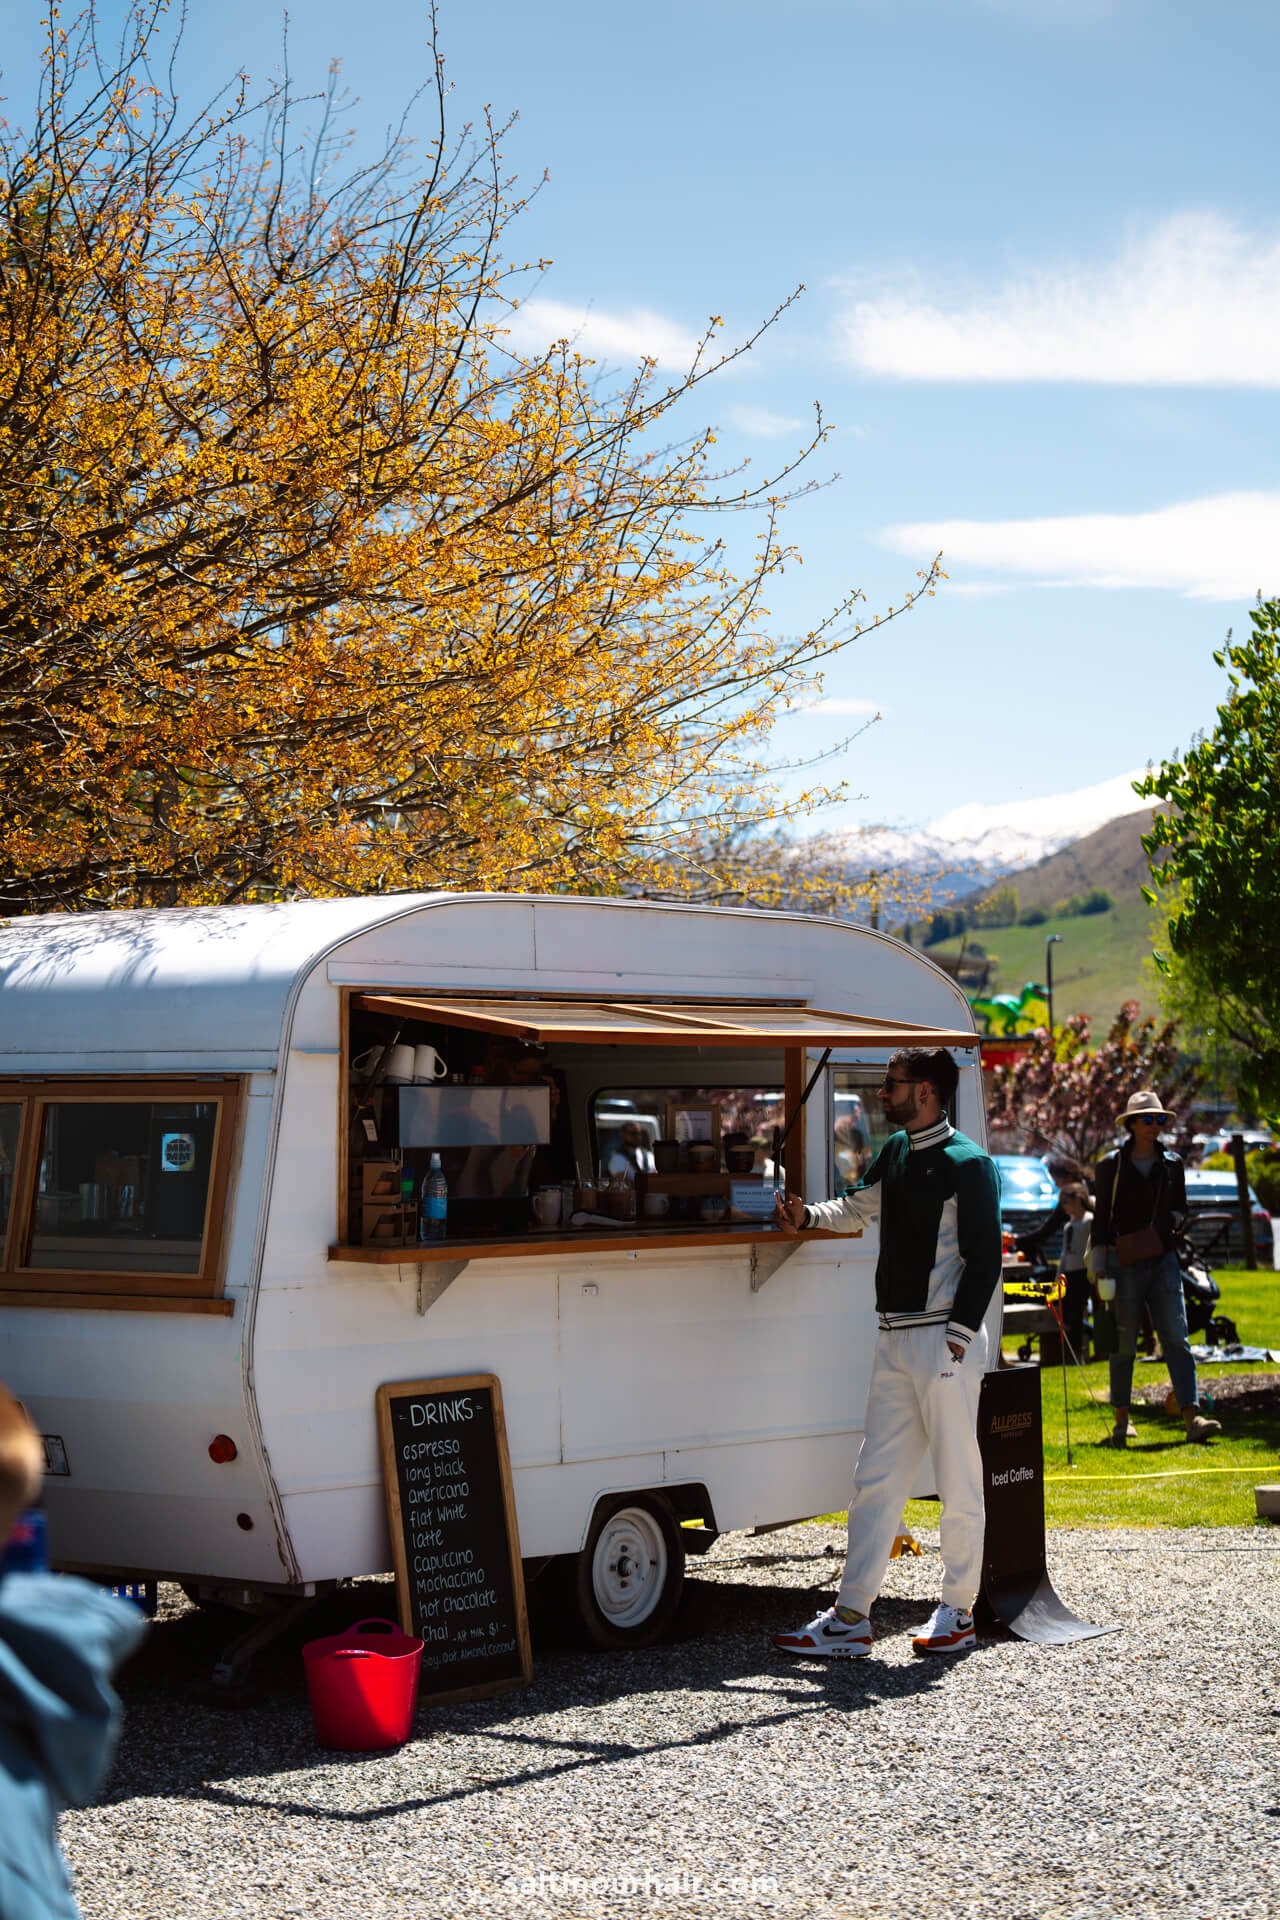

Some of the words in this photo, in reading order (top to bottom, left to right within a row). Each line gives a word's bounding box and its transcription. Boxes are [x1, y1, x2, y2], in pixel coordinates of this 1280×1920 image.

[410, 1397, 474, 1427] DRINKS
[403, 1439, 461, 1460] espresso
[406, 1470, 431, 1486] long
[435, 1457, 466, 1478] black
[991, 1470, 1009, 1487] Iced
[1009, 1466, 1034, 1483] Coffee
[410, 1508, 433, 1528] flat
[411, 1528, 444, 1549] latte
[419, 1600, 440, 1619] hot
